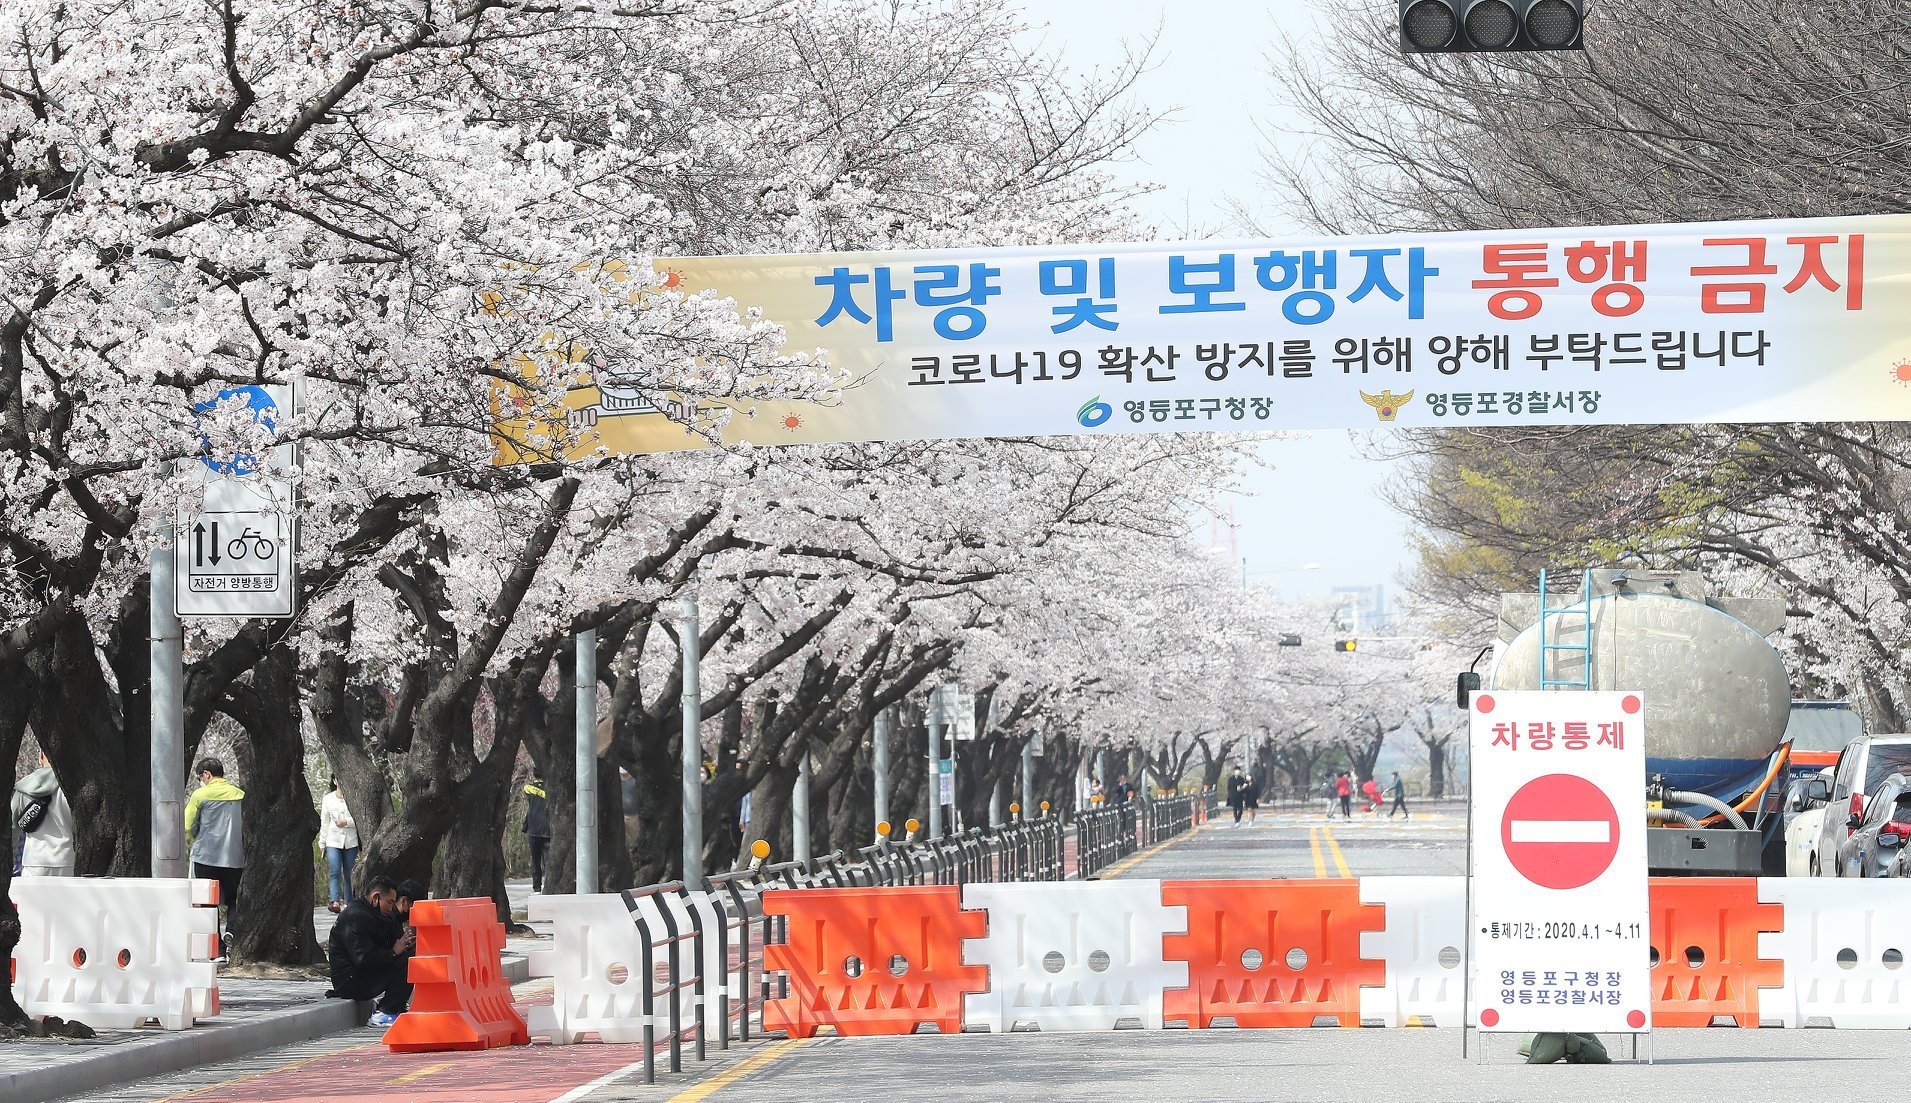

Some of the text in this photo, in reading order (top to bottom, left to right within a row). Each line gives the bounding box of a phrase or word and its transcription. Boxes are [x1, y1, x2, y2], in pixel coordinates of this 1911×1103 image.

[816, 233, 1865, 342] 차량 및 보행자 통행 금지
[907, 330, 1771, 386] 코로나19 확산 방지를 위해 양해 부탁드립니다
[1123, 396, 1274, 424] 영등포구청장
[1426, 391, 1602, 418] 영등포경찰서장
[194, 576, 274, 589] 자전거 양방통행
[1491, 721, 1625, 751] 차량통제
[1500, 989, 1622, 1005] 영등포경찰서장
